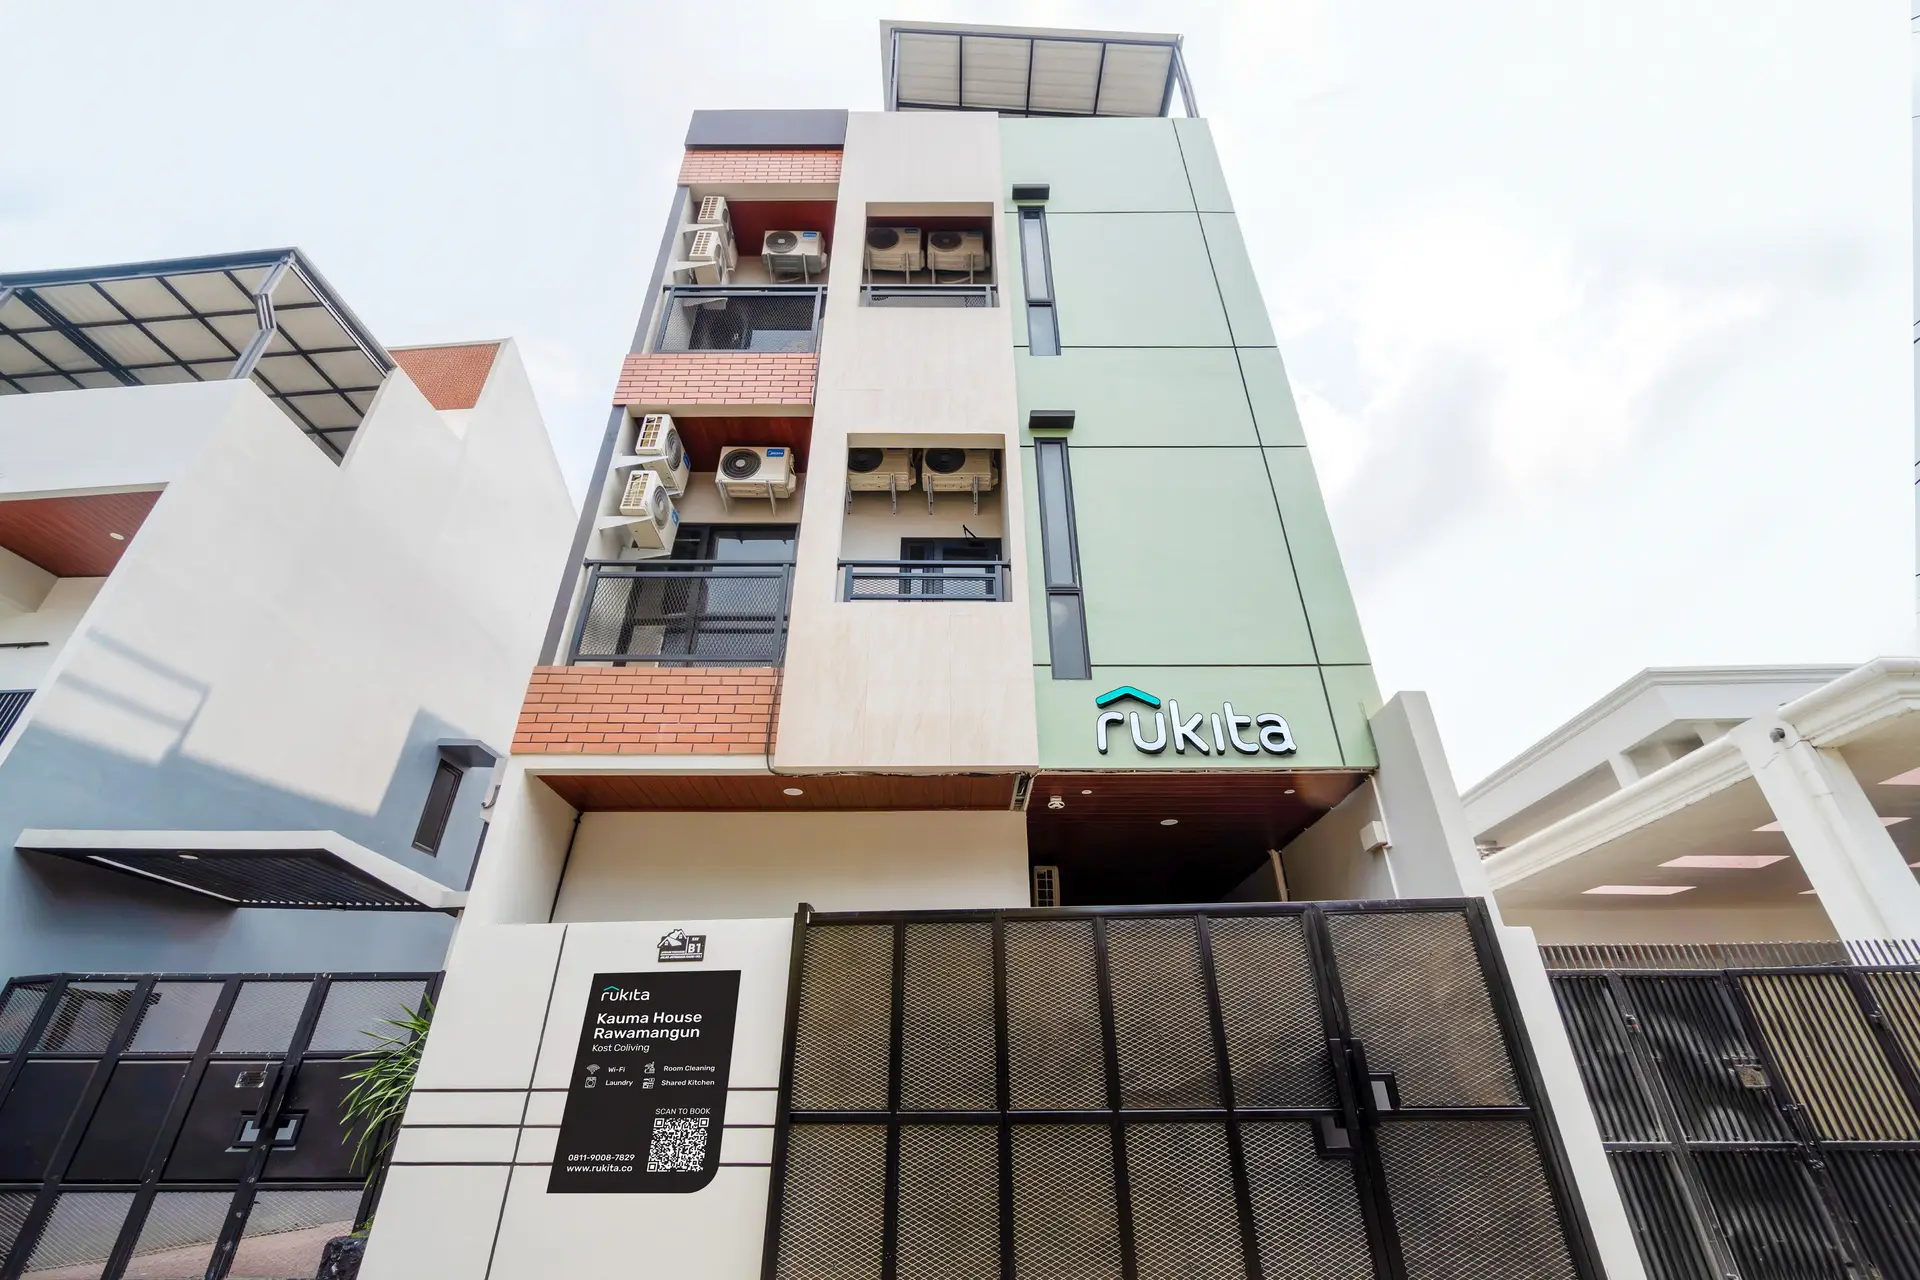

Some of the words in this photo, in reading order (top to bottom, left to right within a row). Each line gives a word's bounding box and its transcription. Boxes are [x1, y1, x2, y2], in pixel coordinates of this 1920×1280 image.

[1096, 699, 1297, 756] rukita
[688, 943, 701, 953] B1
[601, 989, 650, 1002] rukita
[597, 1013, 649, 1025] Kauma
[653, 1012, 703, 1024] House
[594, 1028, 700, 1041] Rawamangun
[592, 1044, 612, 1053] Kost
[614, 1043, 650, 1054] Coliving
[685, 1064, 716, 1073] Cleaning
[566, 1164, 633, 1172] www.rukita.co
